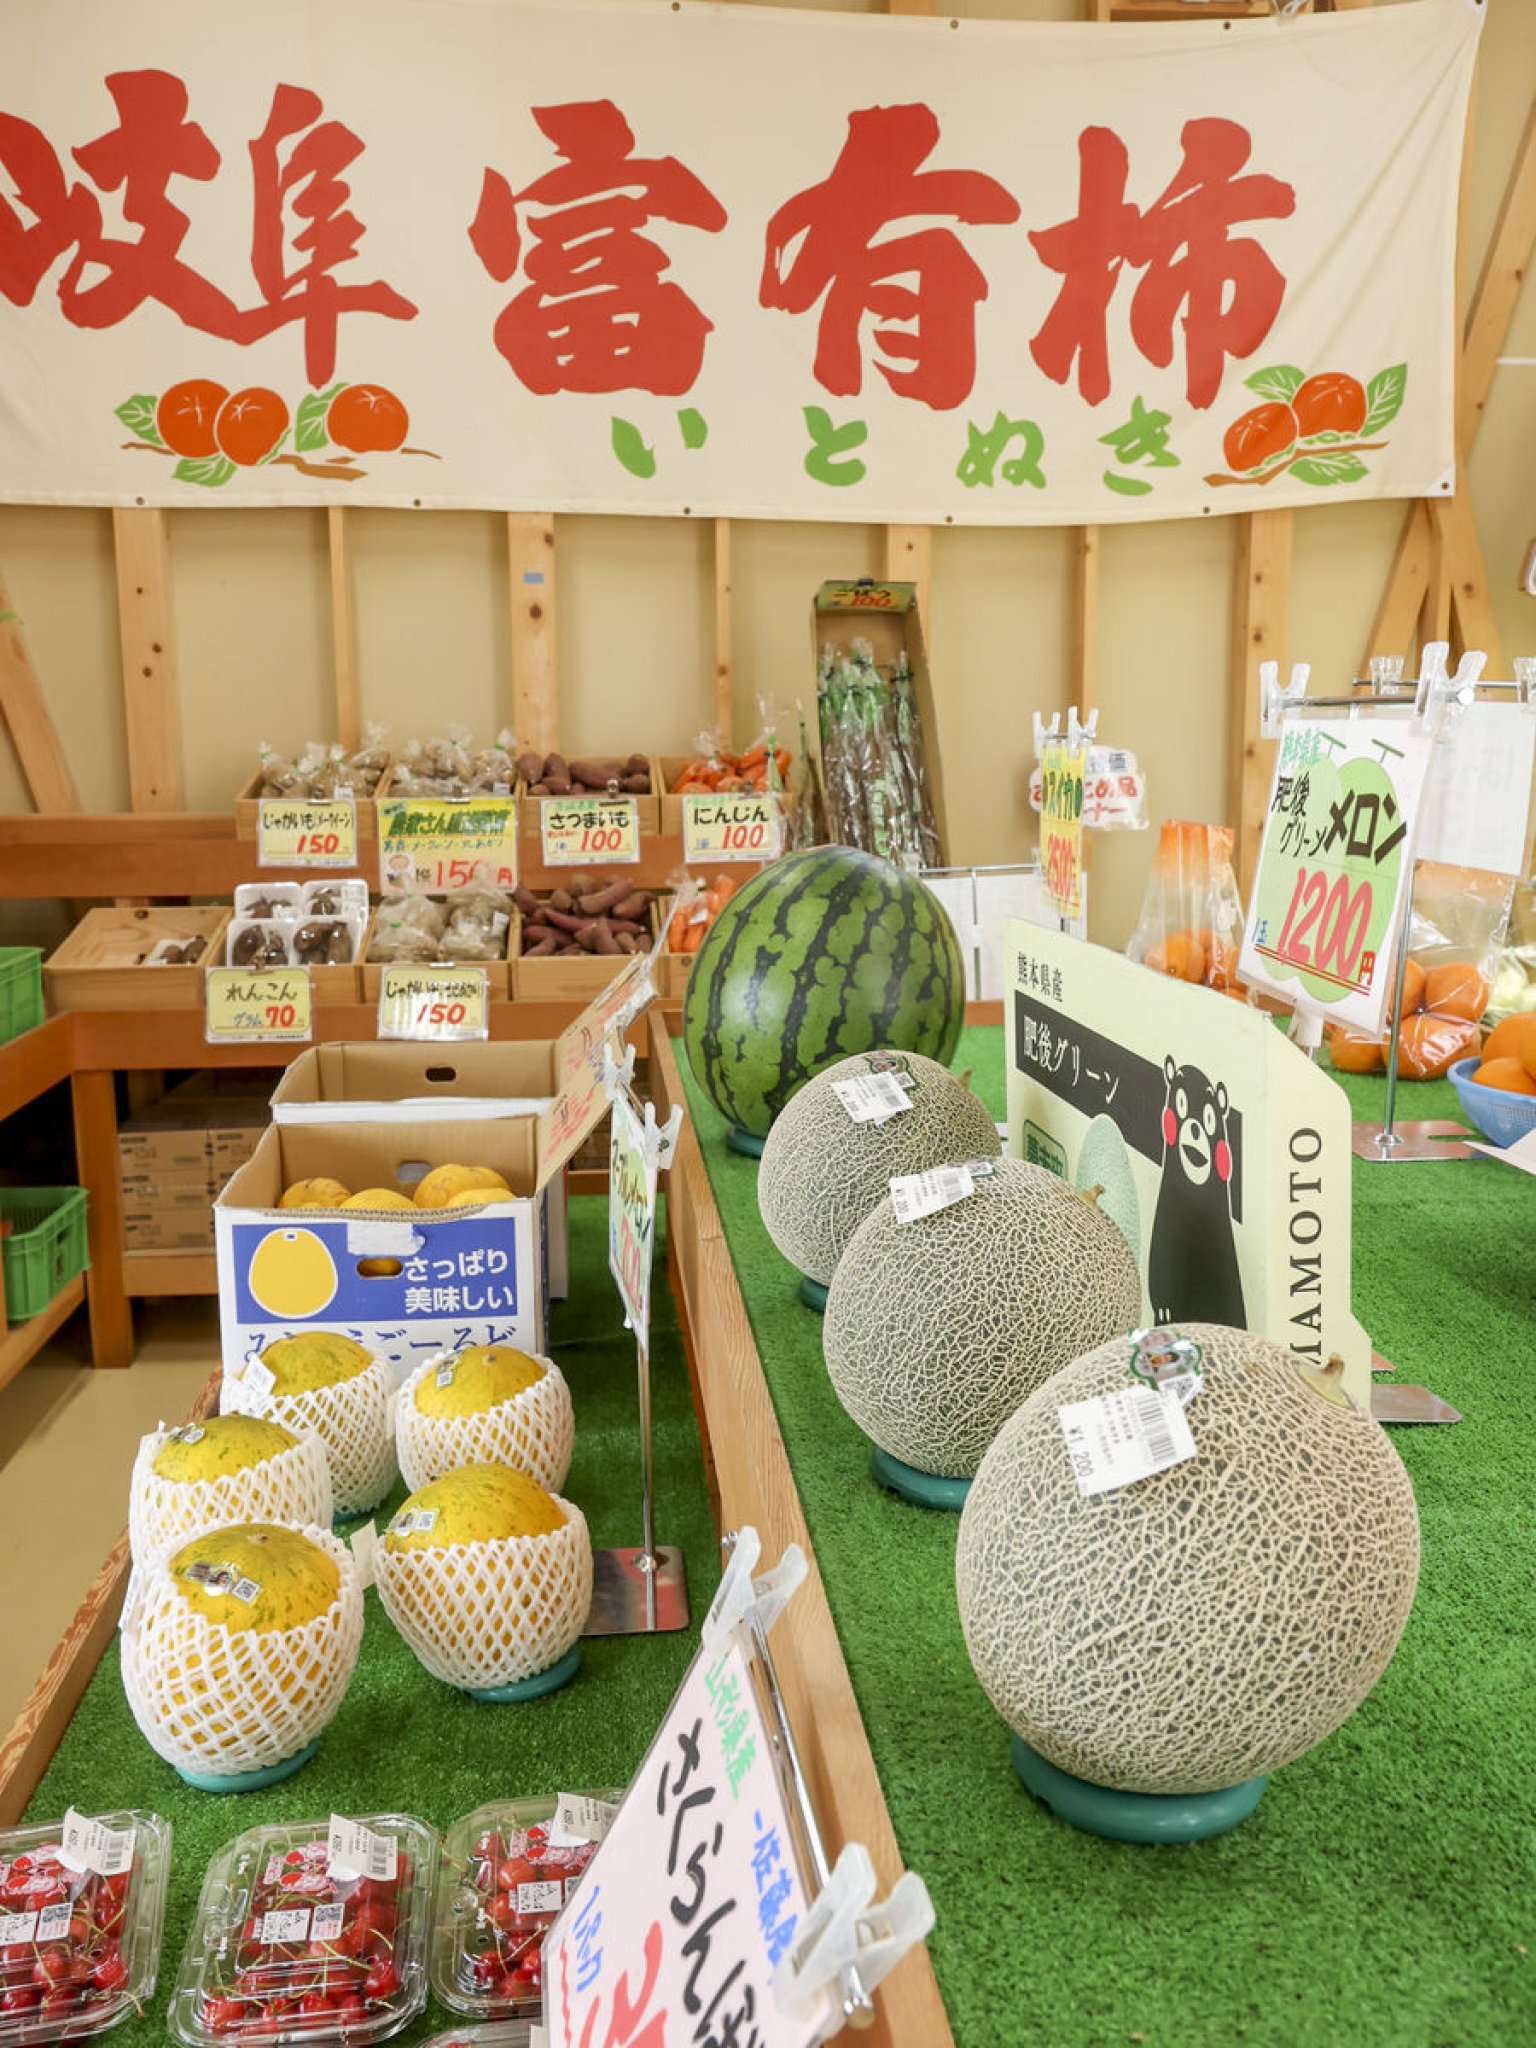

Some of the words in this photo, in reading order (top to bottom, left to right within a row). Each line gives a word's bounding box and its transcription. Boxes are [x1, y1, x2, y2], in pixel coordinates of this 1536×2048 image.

[549, 811, 631, 831] さつまいも
[693, 804, 769, 825] にんじん
[1323, 788, 1408, 866] メロン
[296, 832, 340, 855] 150
[580, 827, 623, 853] 100
[720, 822, 765, 850] 100
[1276, 866, 1373, 979] 1200
[225, 982, 297, 1001] れんこん
[265, 1004, 295, 1029] 70
[416, 1003, 466, 1025] 150
[1022, 1013, 1121, 1105] 肥後グリーン
[403, 1248, 509, 1284] さっぱり
[404, 1286, 515, 1314] 美味しい
